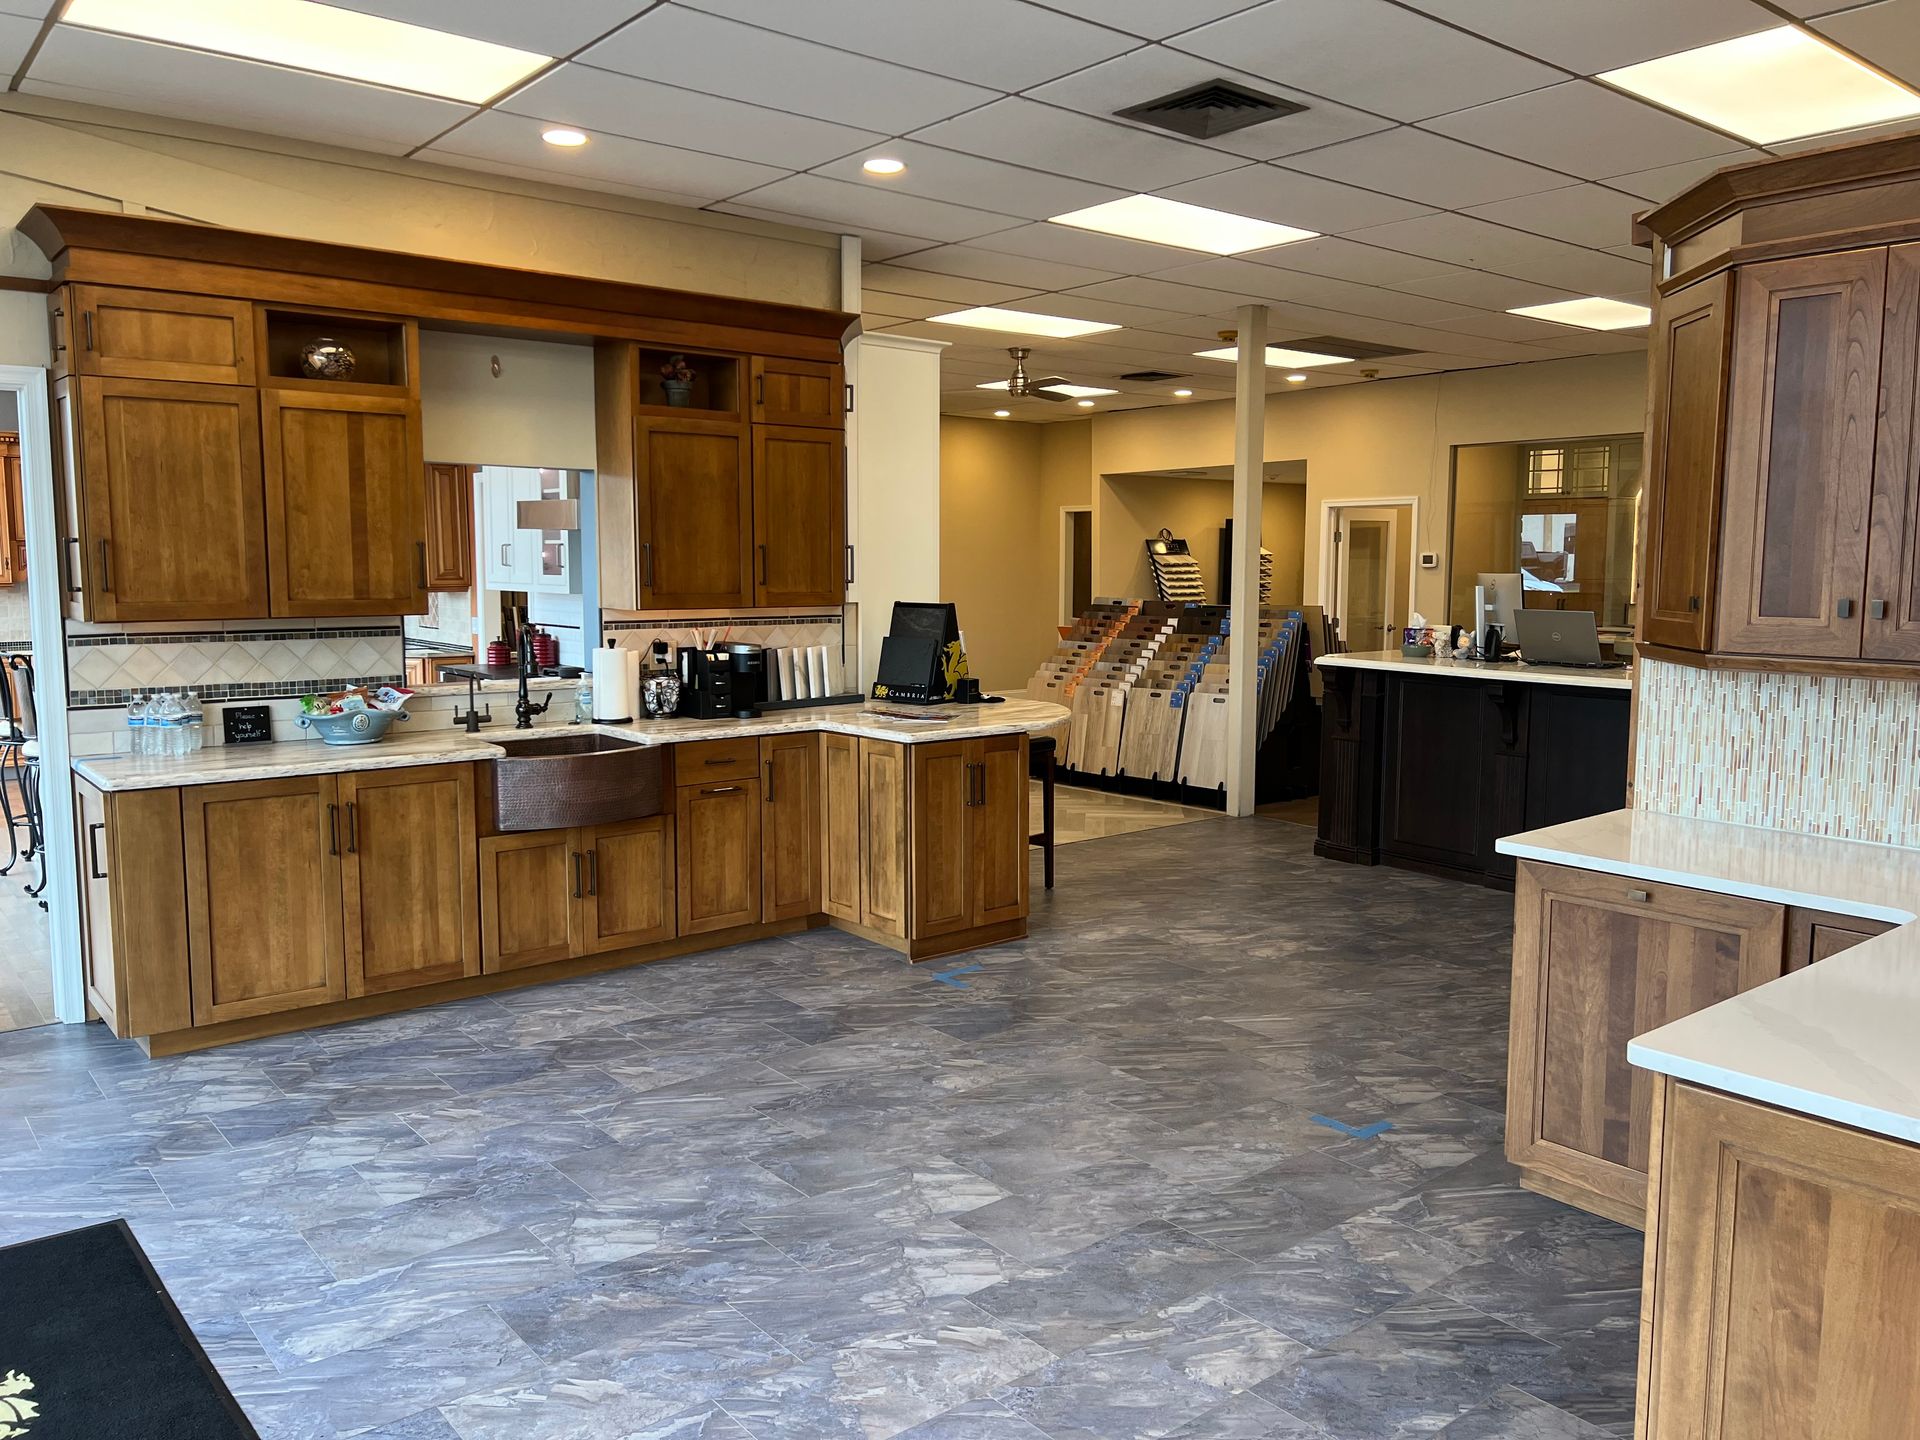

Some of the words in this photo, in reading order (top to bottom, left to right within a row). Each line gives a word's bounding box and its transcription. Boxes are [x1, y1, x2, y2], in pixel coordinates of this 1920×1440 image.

[889, 690, 925, 699] CAMBRIA
[238, 722, 252, 732] help
[235, 730, 260, 742] yourself
